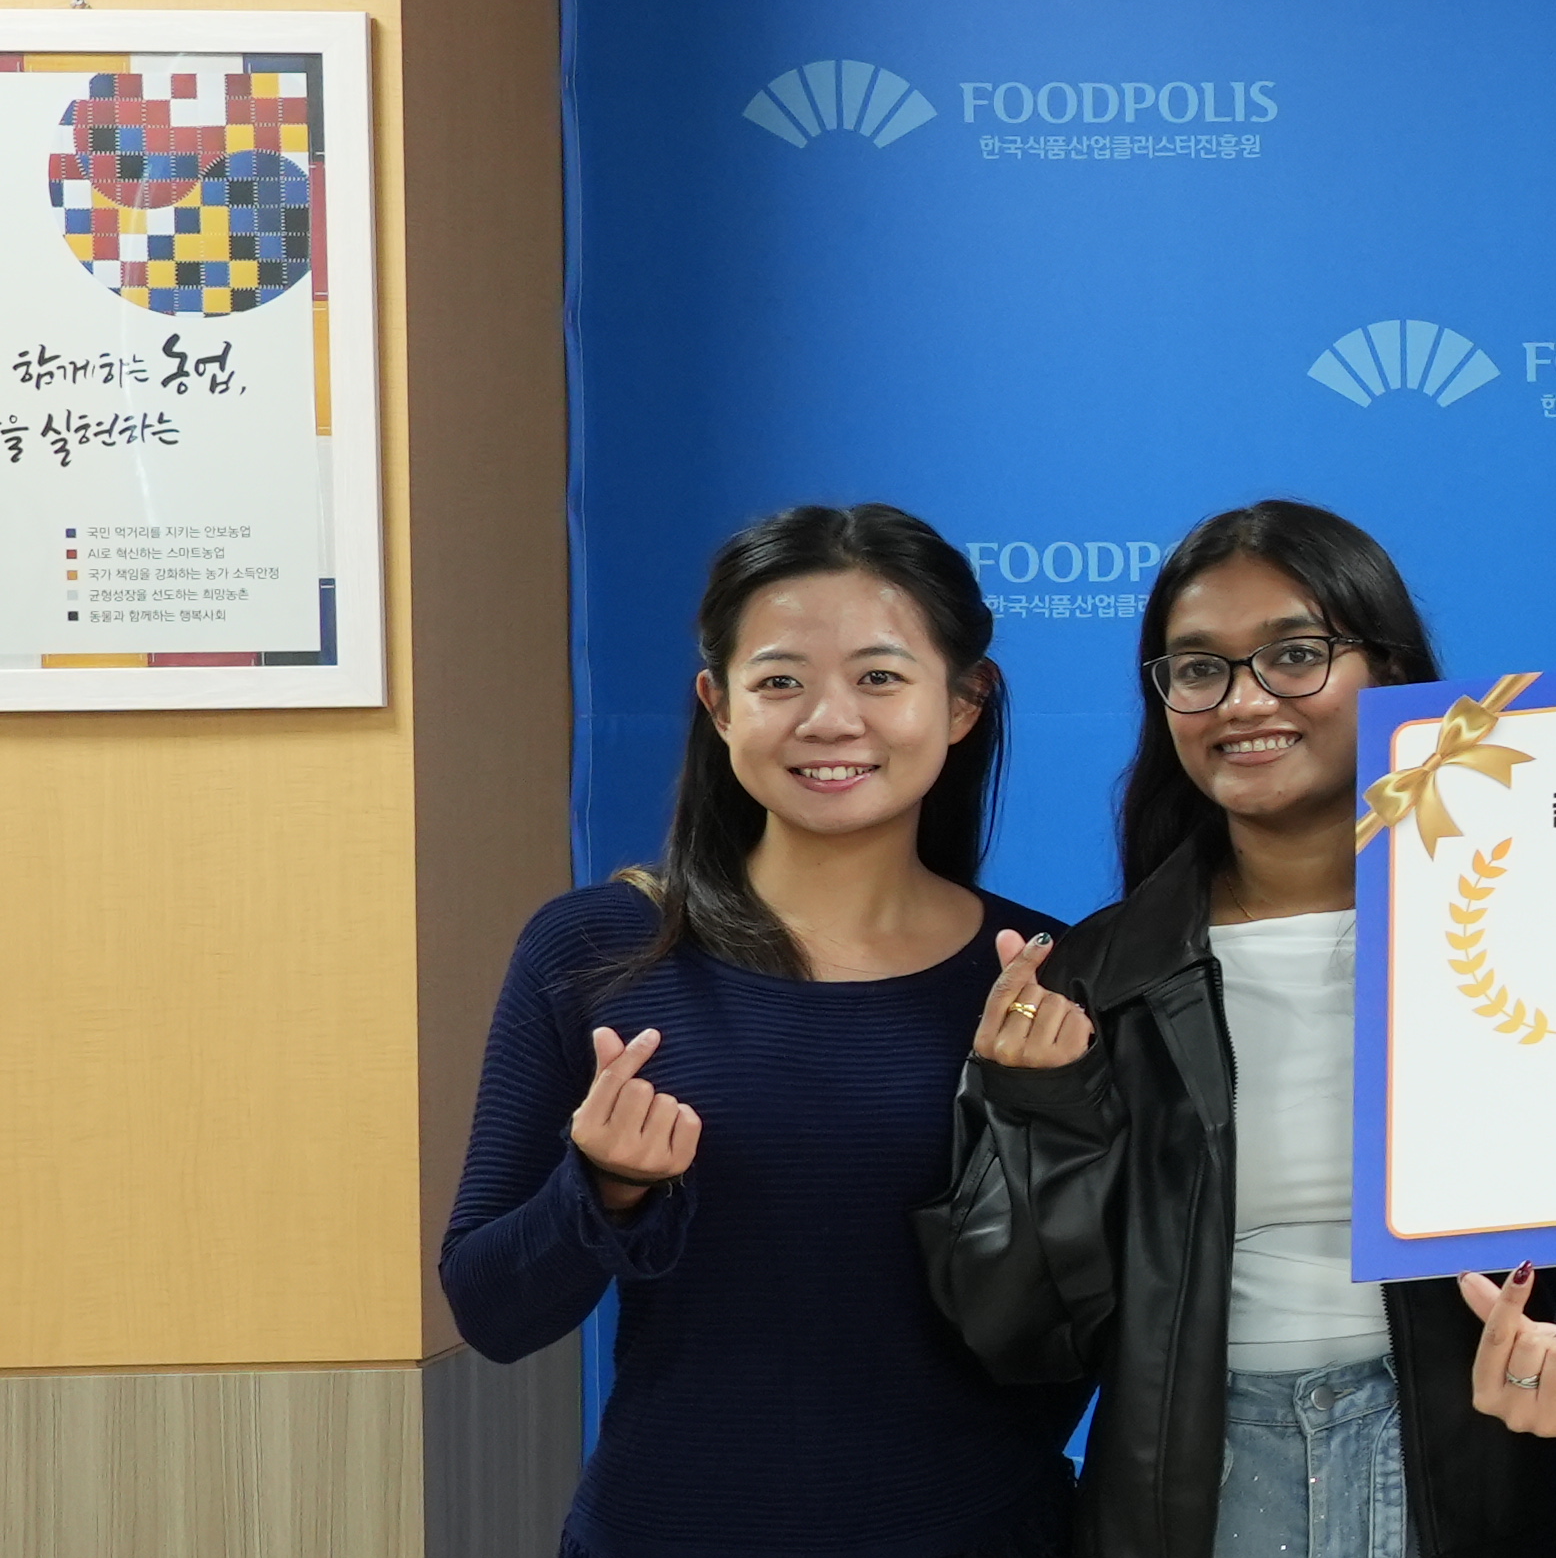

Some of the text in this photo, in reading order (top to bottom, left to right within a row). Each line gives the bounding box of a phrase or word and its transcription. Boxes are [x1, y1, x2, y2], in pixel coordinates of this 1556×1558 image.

[960, 81, 1277, 123] FOODPOLIS
[980, 134, 1260, 159] 한국식품산업클러스터진흥원
[161, 334, 246, 394] 농업,
[41, 409, 179, 467] 실현하는
[86, 525, 252, 540] 국민 먹거리를 지키는 안보농업
[87, 547, 225, 560] AI로 혁신하는 스마트농업
[966, 541, 1181, 583] FOODP
[88, 567, 280, 581] 국가 책임을 강화하는 농가 소득안정
[88, 588, 250, 602] 균형성장을 선도하는 희망농촌
[984, 594, 1150, 619] 한국식품산업클
[89, 609, 227, 622] 동물과 함께하는 행복사회
